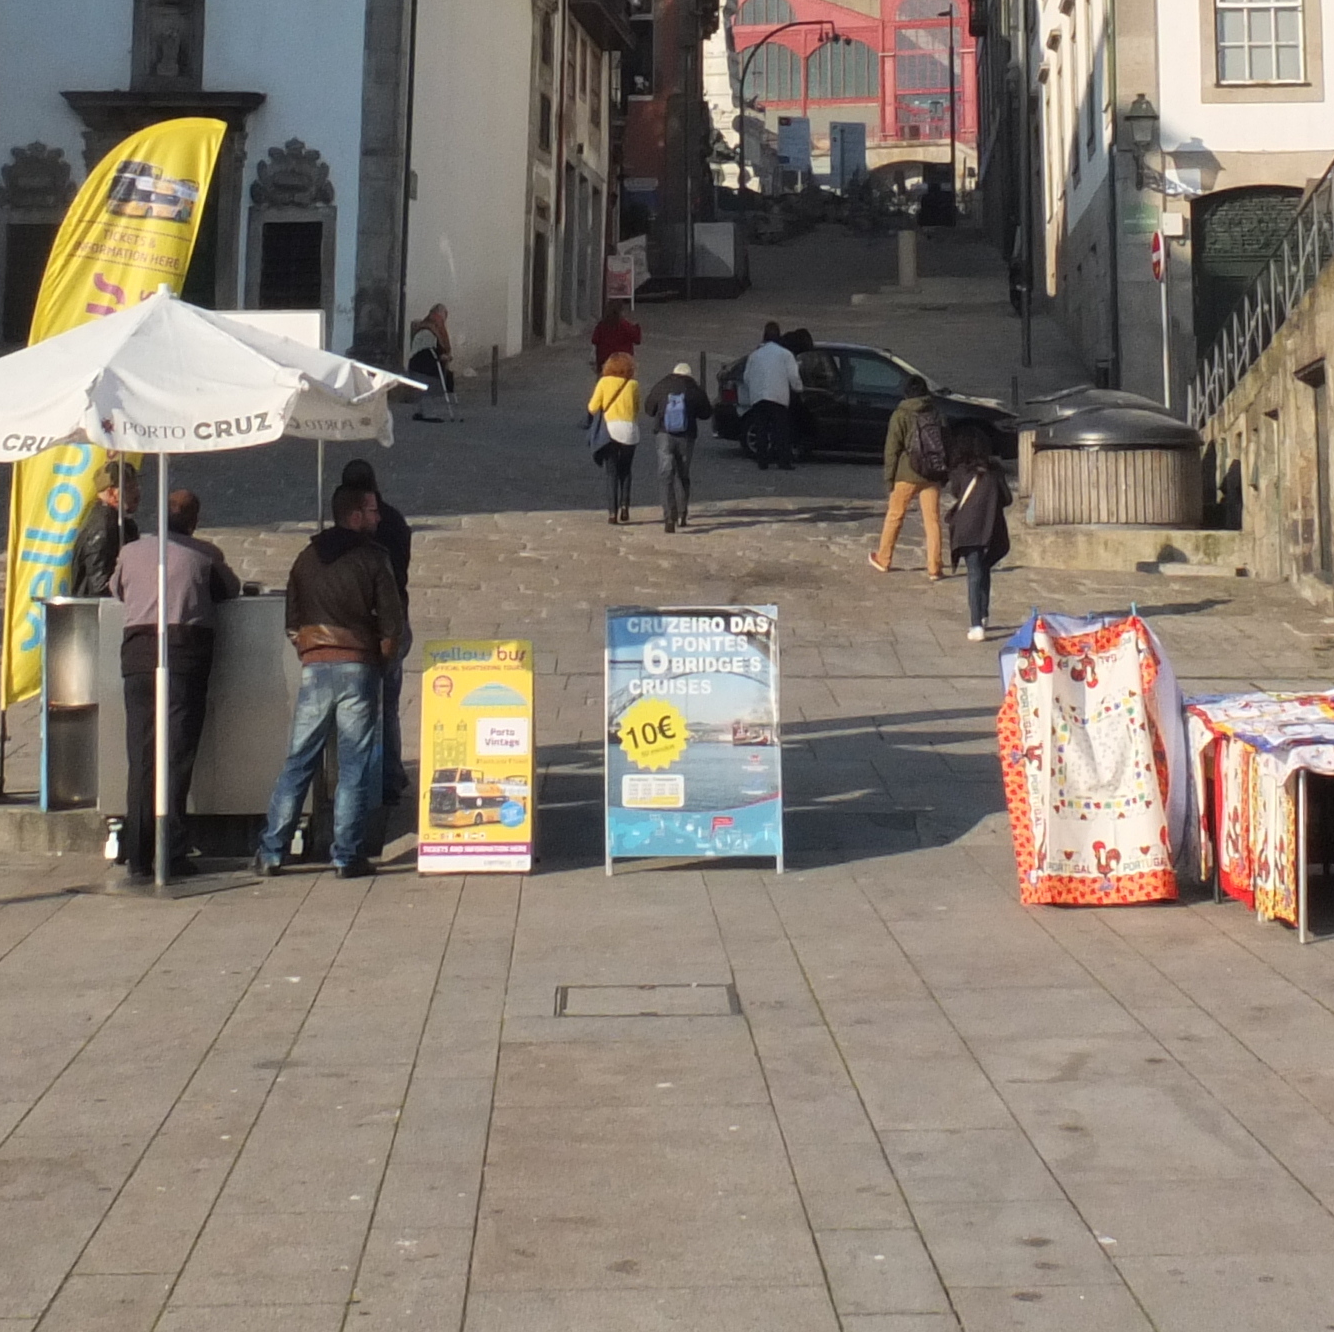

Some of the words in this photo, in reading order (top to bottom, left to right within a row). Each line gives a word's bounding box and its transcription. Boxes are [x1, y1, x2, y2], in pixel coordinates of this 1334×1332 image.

[103, 229, 147, 247] TICKETS
[74, 241, 148, 262] INFORMATION
[151, 254, 181, 269] HERE
[122, 420, 186, 439] PORTO
[193, 411, 273, 441] CRUZ
[627, 616, 725, 634] CRUZEIRO
[730, 616, 769, 634] DAS
[496, 646, 527, 662] bus
[643, 635, 670, 675] 6
[671, 637, 749, 652] PONTES
[629, 679, 712, 695] CRUISES
[490, 728, 516, 736] Porto
[626, 715, 676, 749] 10€
[485, 738, 520, 748] Vintage
[1046, 862, 1092, 874] PORTUGAL
